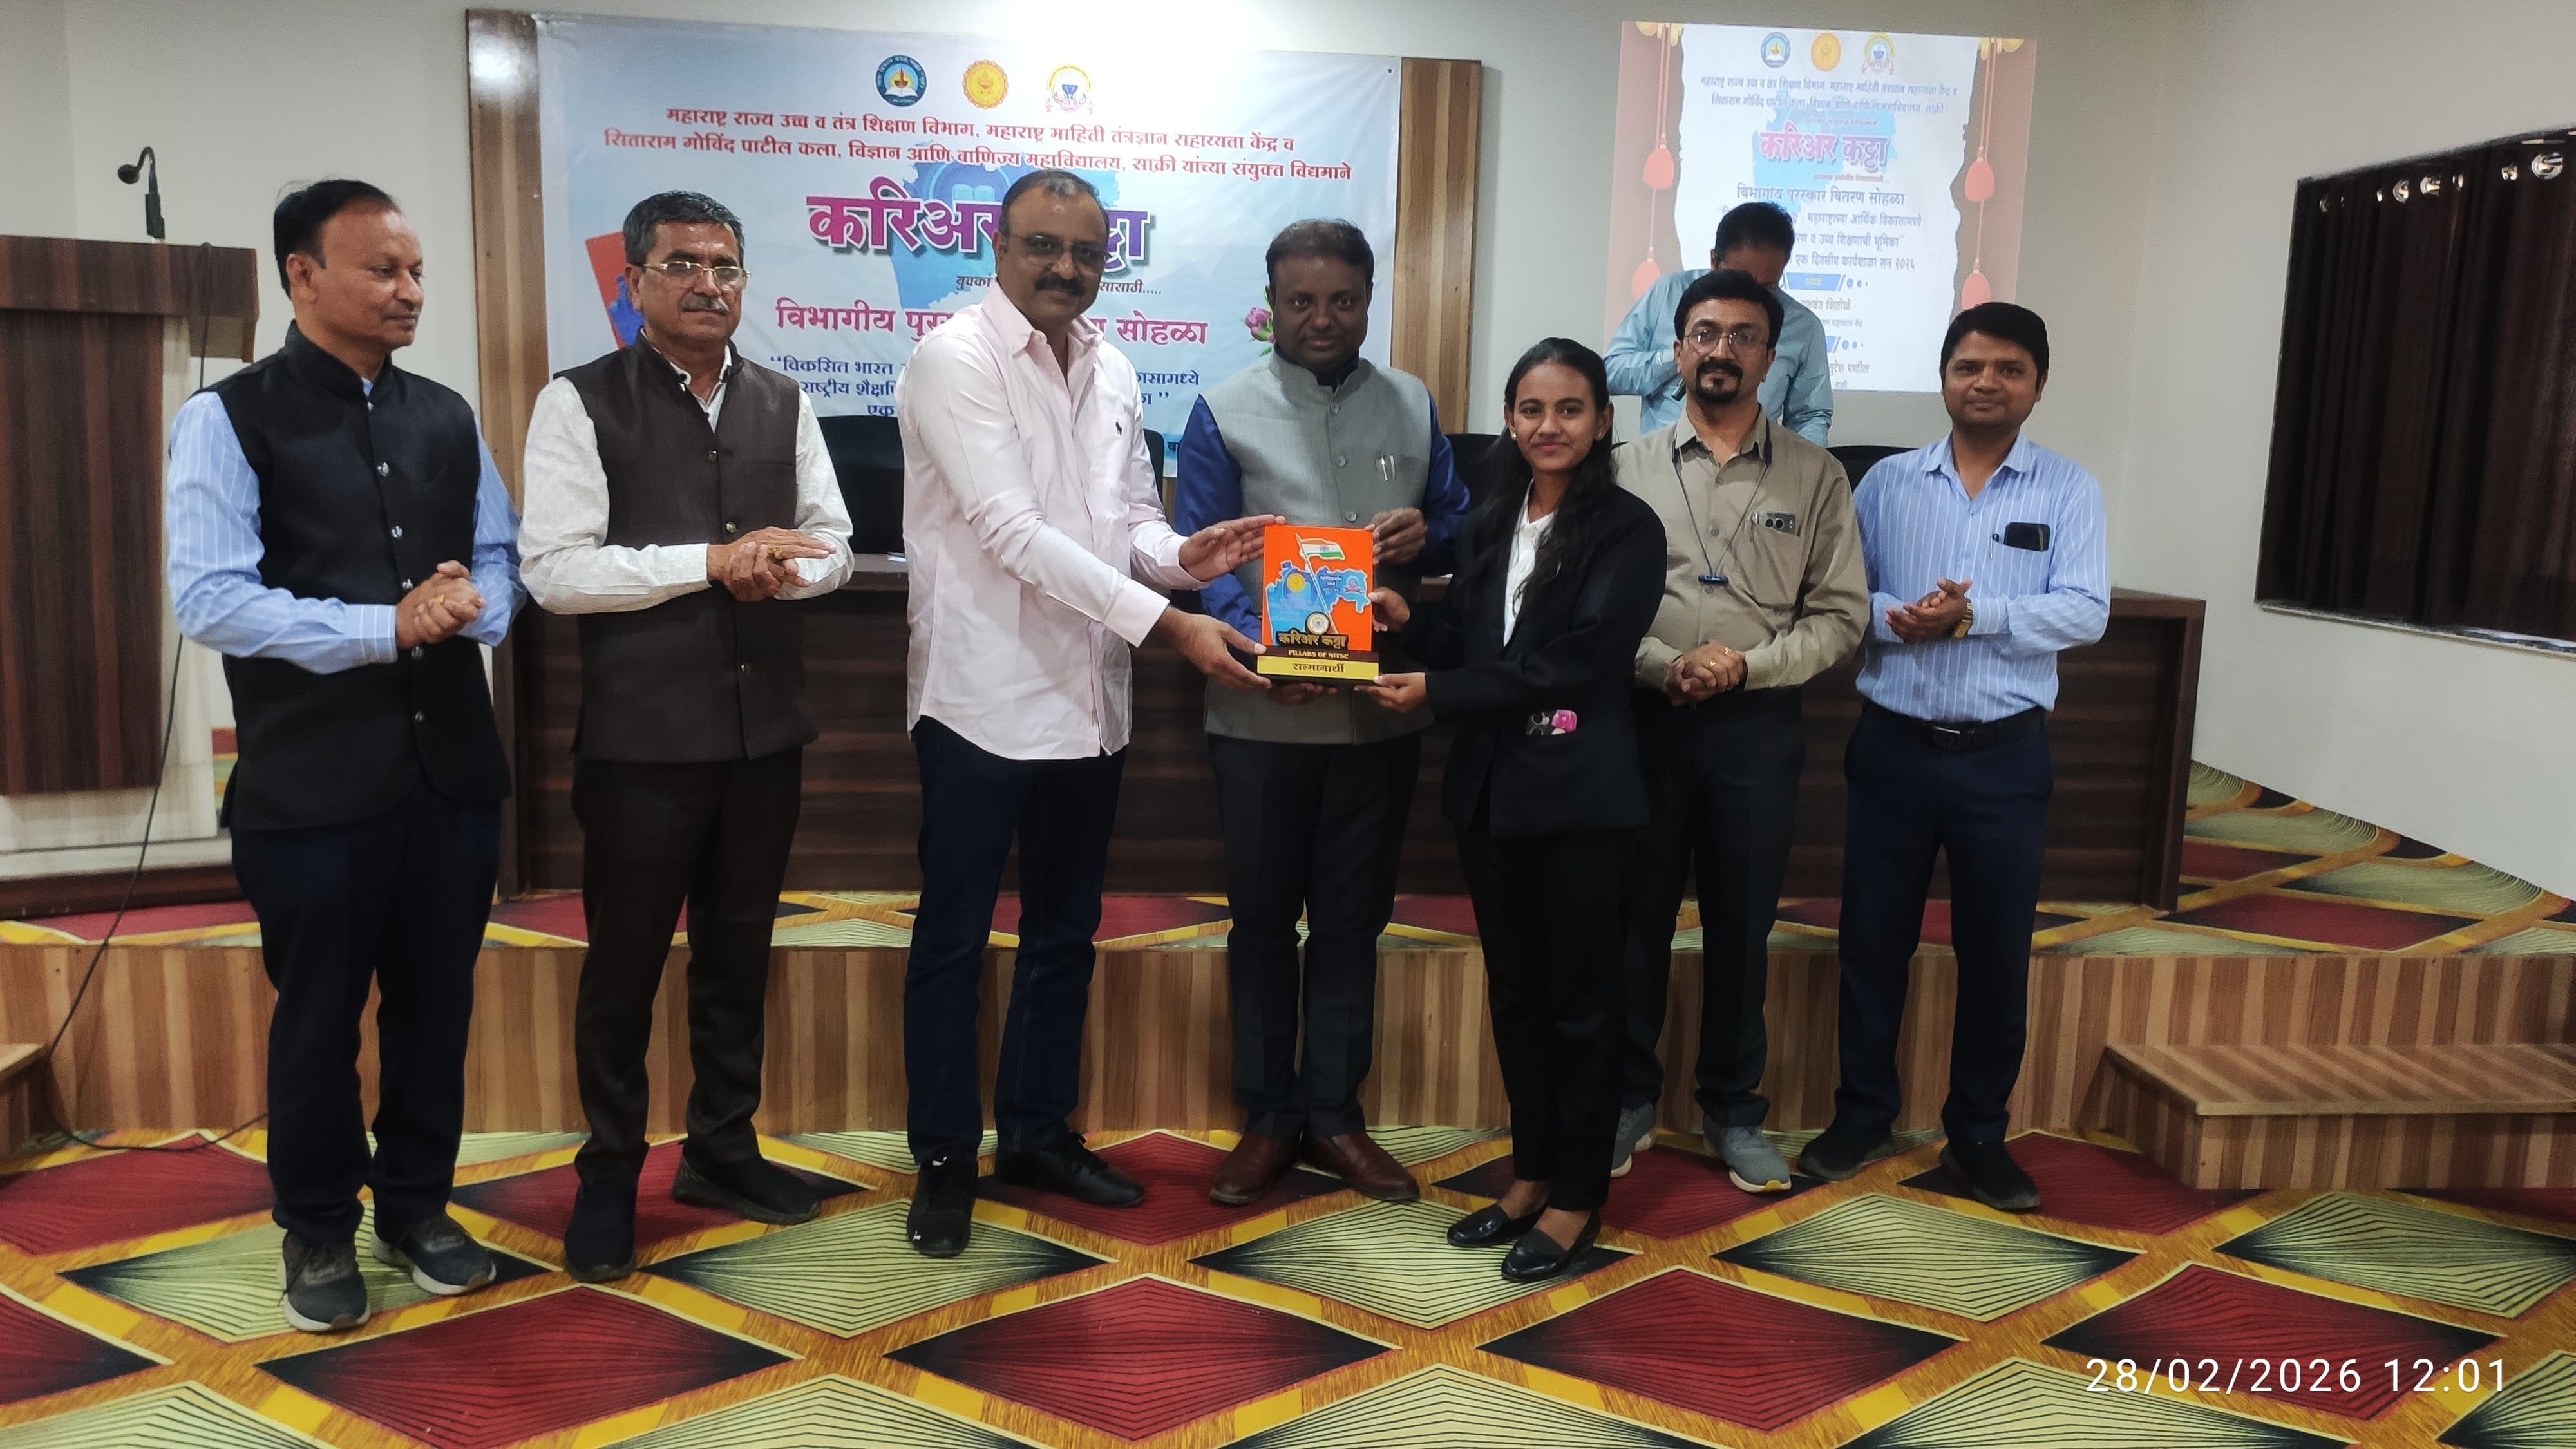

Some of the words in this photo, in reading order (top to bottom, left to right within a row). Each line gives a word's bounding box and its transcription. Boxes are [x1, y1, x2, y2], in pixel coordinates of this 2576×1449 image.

[667, 108, 727, 127] महाराष्ट्र
[733, 111, 774, 127] राज्य
[781, 114, 809, 129] उच्च
[815, 116, 826, 129] व
[833, 111, 857, 131] तंत्र
[862, 113, 917, 134] शिक्षण
[923, 115, 980, 138] विभाग,
[985, 124, 1044, 144] महाराष्ट्र
[1050, 124, 1104, 144] माहिती
[1111, 126, 1168, 146] तंत्रज्ञान
[1250, 131, 1278, 153] केंद्र
[1283, 137, 1295, 151] व
[604, 127, 676, 149] सिताराम
[683, 131, 735, 154] गोविंद
[741, 135, 793, 155] पाटील
[798, 141, 842, 159] कला,
[849, 138, 902, 160] विज्ञान
[907, 143, 952, 162] आणि
[957, 146, 1021, 166] वाणिज्य
[1026, 149, 1126, 172] महाविद्यालय,
[1132, 154, 1177, 173] साक्री
[1182, 155, 1227, 175] यांच्या
[1232, 157, 1285, 182] संयुक्त
[1290, 159, 1352, 180] विद्यमाने
[1760, 120, 1837, 160] करिअर
[1842, 133, 1889, 171] कट्टा
[1737, 182, 1783, 200] विभागीय
[1787, 188, 1826, 205] पुरस्कार
[1830, 185, 1865, 204] वितरण
[1869, 187, 1905, 206] सोहळा
[1795, 233, 1807, 245] रण
[956, 272, 992, 291] युवकां
[1098, 279, 1162, 294] सासाठी.....
[776, 296, 896, 332] विभागीय
[1116, 310, 1209, 345] सोहळा
[855, 362, 893, 375] भारत
[867, 404, 895, 417] एक
[1278, 629, 1320, 646] करिअर
[1288, 649, 1317, 658] PILLARS
